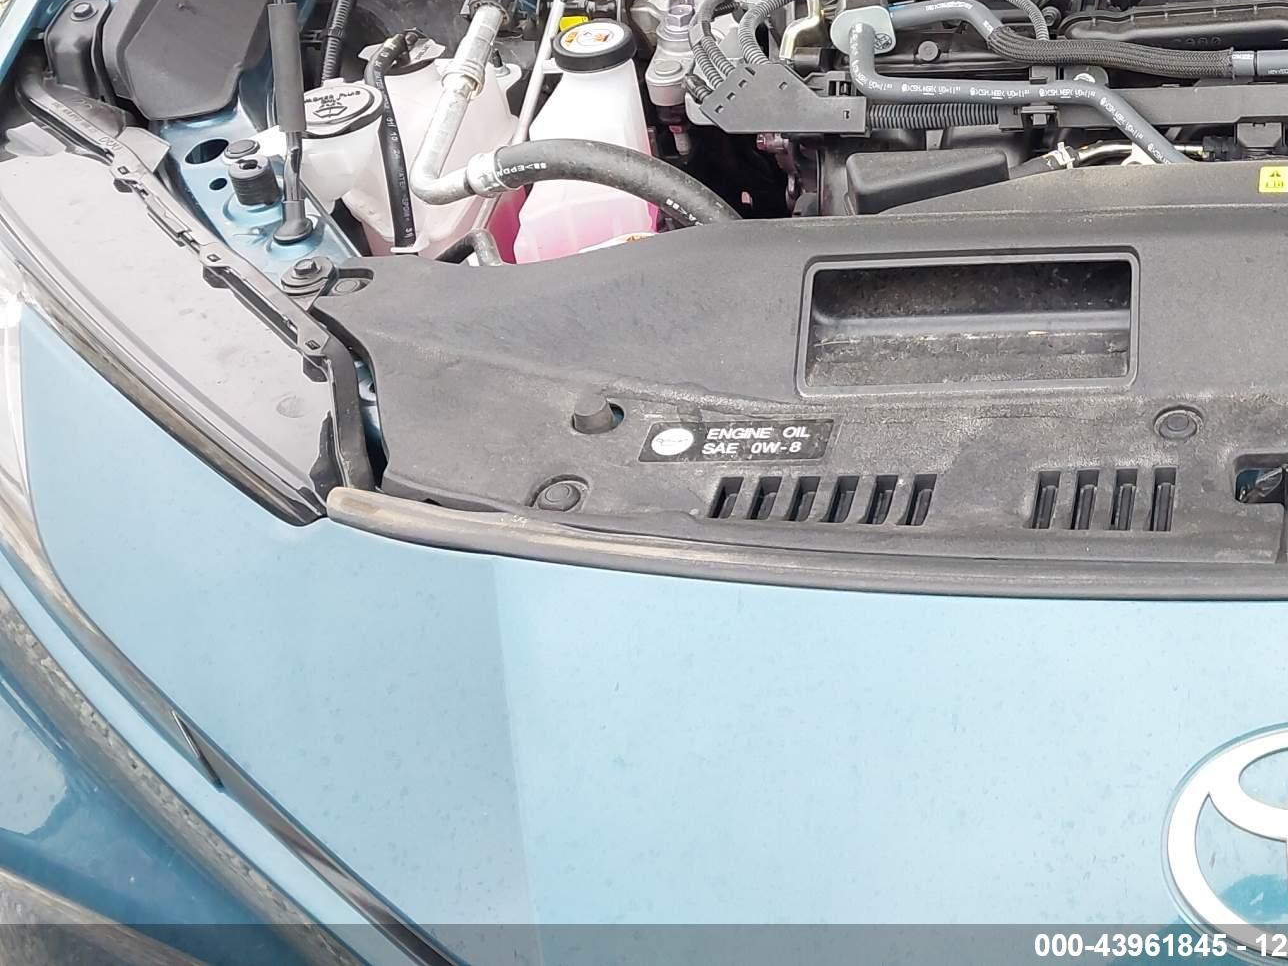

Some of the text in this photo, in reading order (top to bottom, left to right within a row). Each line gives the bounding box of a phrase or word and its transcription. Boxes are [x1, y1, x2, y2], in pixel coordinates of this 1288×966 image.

[707, 426, 811, 440] ENGINE OIL
[702, 442, 739, 454] SAE
